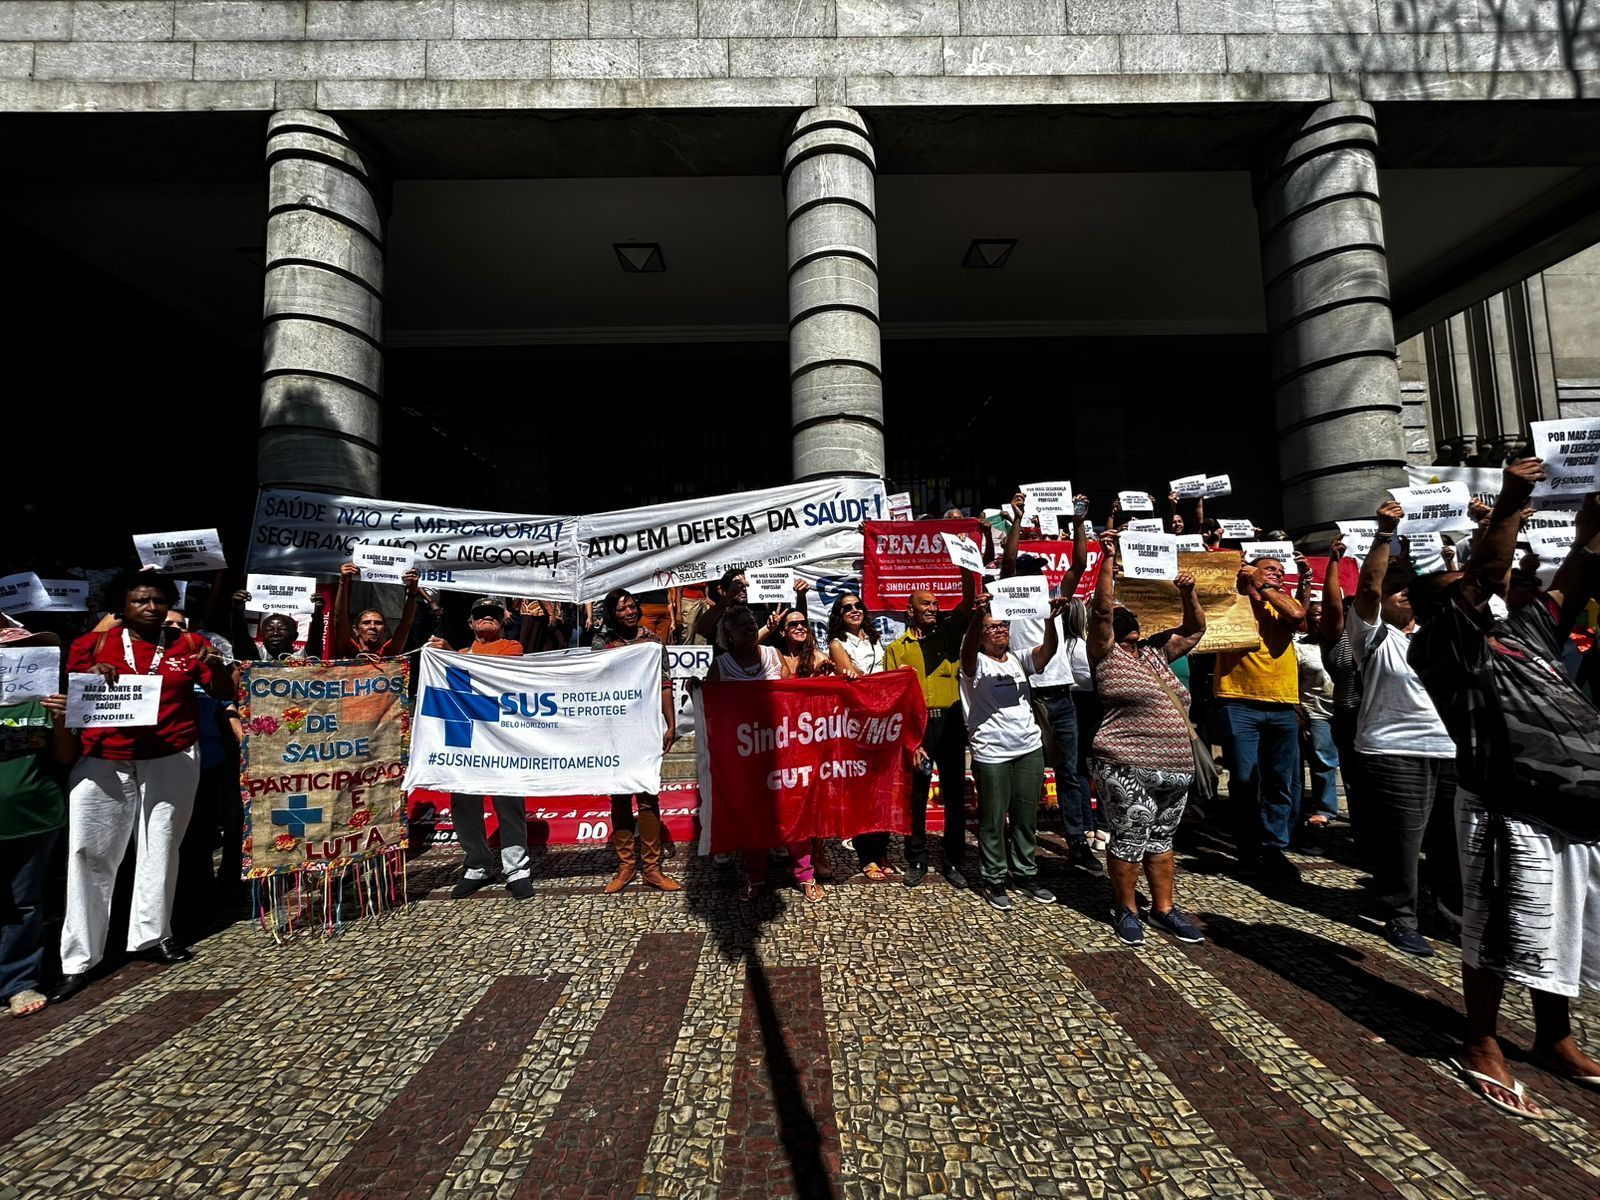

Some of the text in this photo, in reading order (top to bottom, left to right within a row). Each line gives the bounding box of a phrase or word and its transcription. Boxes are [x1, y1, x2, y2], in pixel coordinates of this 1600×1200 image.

[1547, 431, 1566, 442] POR
[1567, 430, 1587, 441] MAIS
[1559, 444, 1570, 454] NO
[1560, 475, 1595, 485] SINDIBEL
[265, 496, 327, 523] SAÚDE
[337, 507, 382, 528] NÃO
[390, 511, 402, 532] É
[414, 516, 564, 548] MERCADORIA!
[587, 533, 628, 559] ATO
[636, 525, 676, 552] EM
[678, 513, 757, 546] DEFESA
[767, 508, 799, 532] DA
[803, 492, 882, 527] SAÚDE!
[256, 525, 369, 558] SEGURANÇ
[424, 543, 451, 561] SE
[457, 545, 559, 578] NEGOCIA!
[876, 533, 951, 555] FENAS
[715, 564, 721, 574] E
[723, 559, 763, 573] ENTIDADES
[1141, 566, 1166, 574] SINDIBEL
[885, 581, 963, 592] SINDICATOS FILIADO
[668, 651, 710, 669] DOR
[132, 684, 143, 692] DE
[250, 675, 405, 700] CONSELHOS
[82, 693, 143, 701] PROFISSIONAIS DA
[95, 701, 122, 710] SAÚDE!
[500, 689, 643, 718] SUS PROTEJA QUEM
[92, 713, 135, 721] SINDIBEL
[562, 705, 627, 717] TE PROTEGE
[306, 714, 340, 734] DE
[500, 721, 559, 729] BELO HORIZONTE
[281, 735, 371, 764] SAÚDE
[427, 752, 620, 770] #SUSNENHUMDIREITOAMENOS
[249, 761, 404, 799] PARTICIPAÇÃO
[767, 765, 813, 790] CUT
[351, 789, 366, 810] E
[575, 821, 609, 840] DO
[305, 825, 386, 860] LUTA
